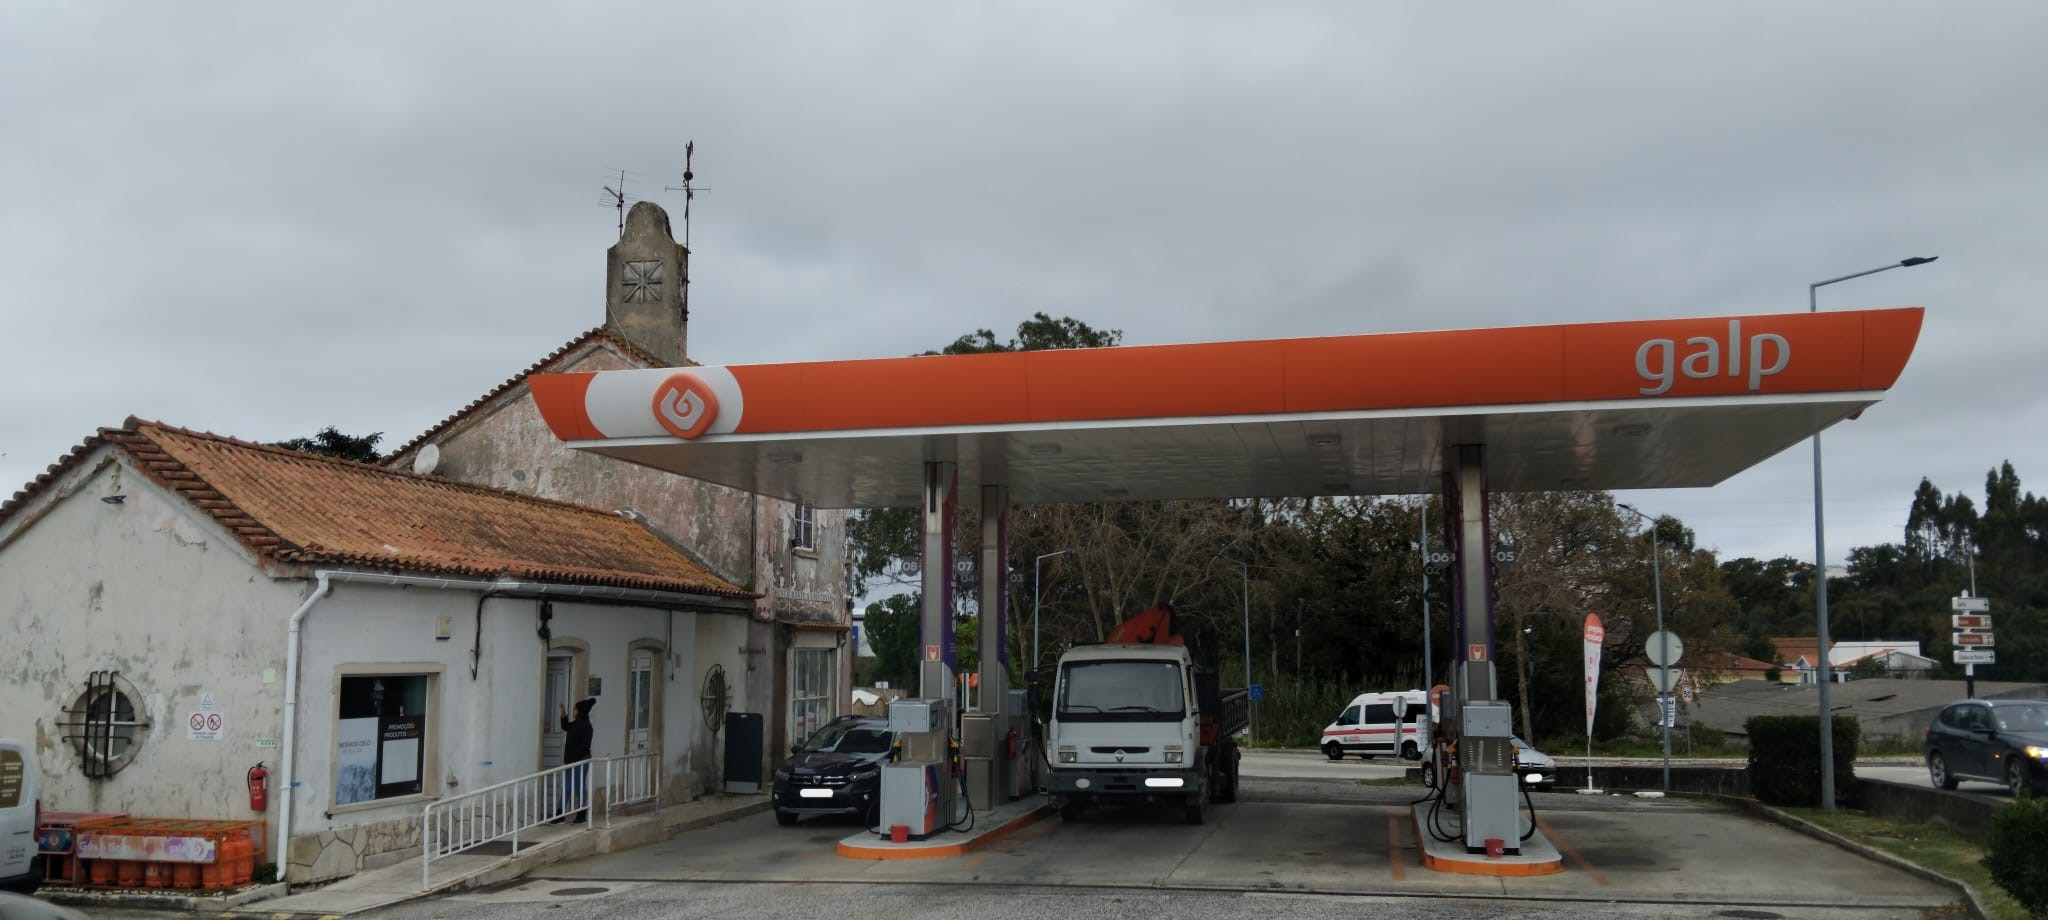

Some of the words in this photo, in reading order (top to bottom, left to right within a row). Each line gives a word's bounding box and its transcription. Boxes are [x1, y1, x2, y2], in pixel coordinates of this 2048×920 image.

[1635, 320, 1791, 395] galp
[1430, 552, 1449, 563] 06
[1496, 551, 1515, 562] 05
[903, 562, 918, 571] 08
[957, 561, 973, 571] 07
[961, 575, 975, 583] 04
[1010, 575, 1024, 583] 03
[1683, 690, 1691, 698] 50
